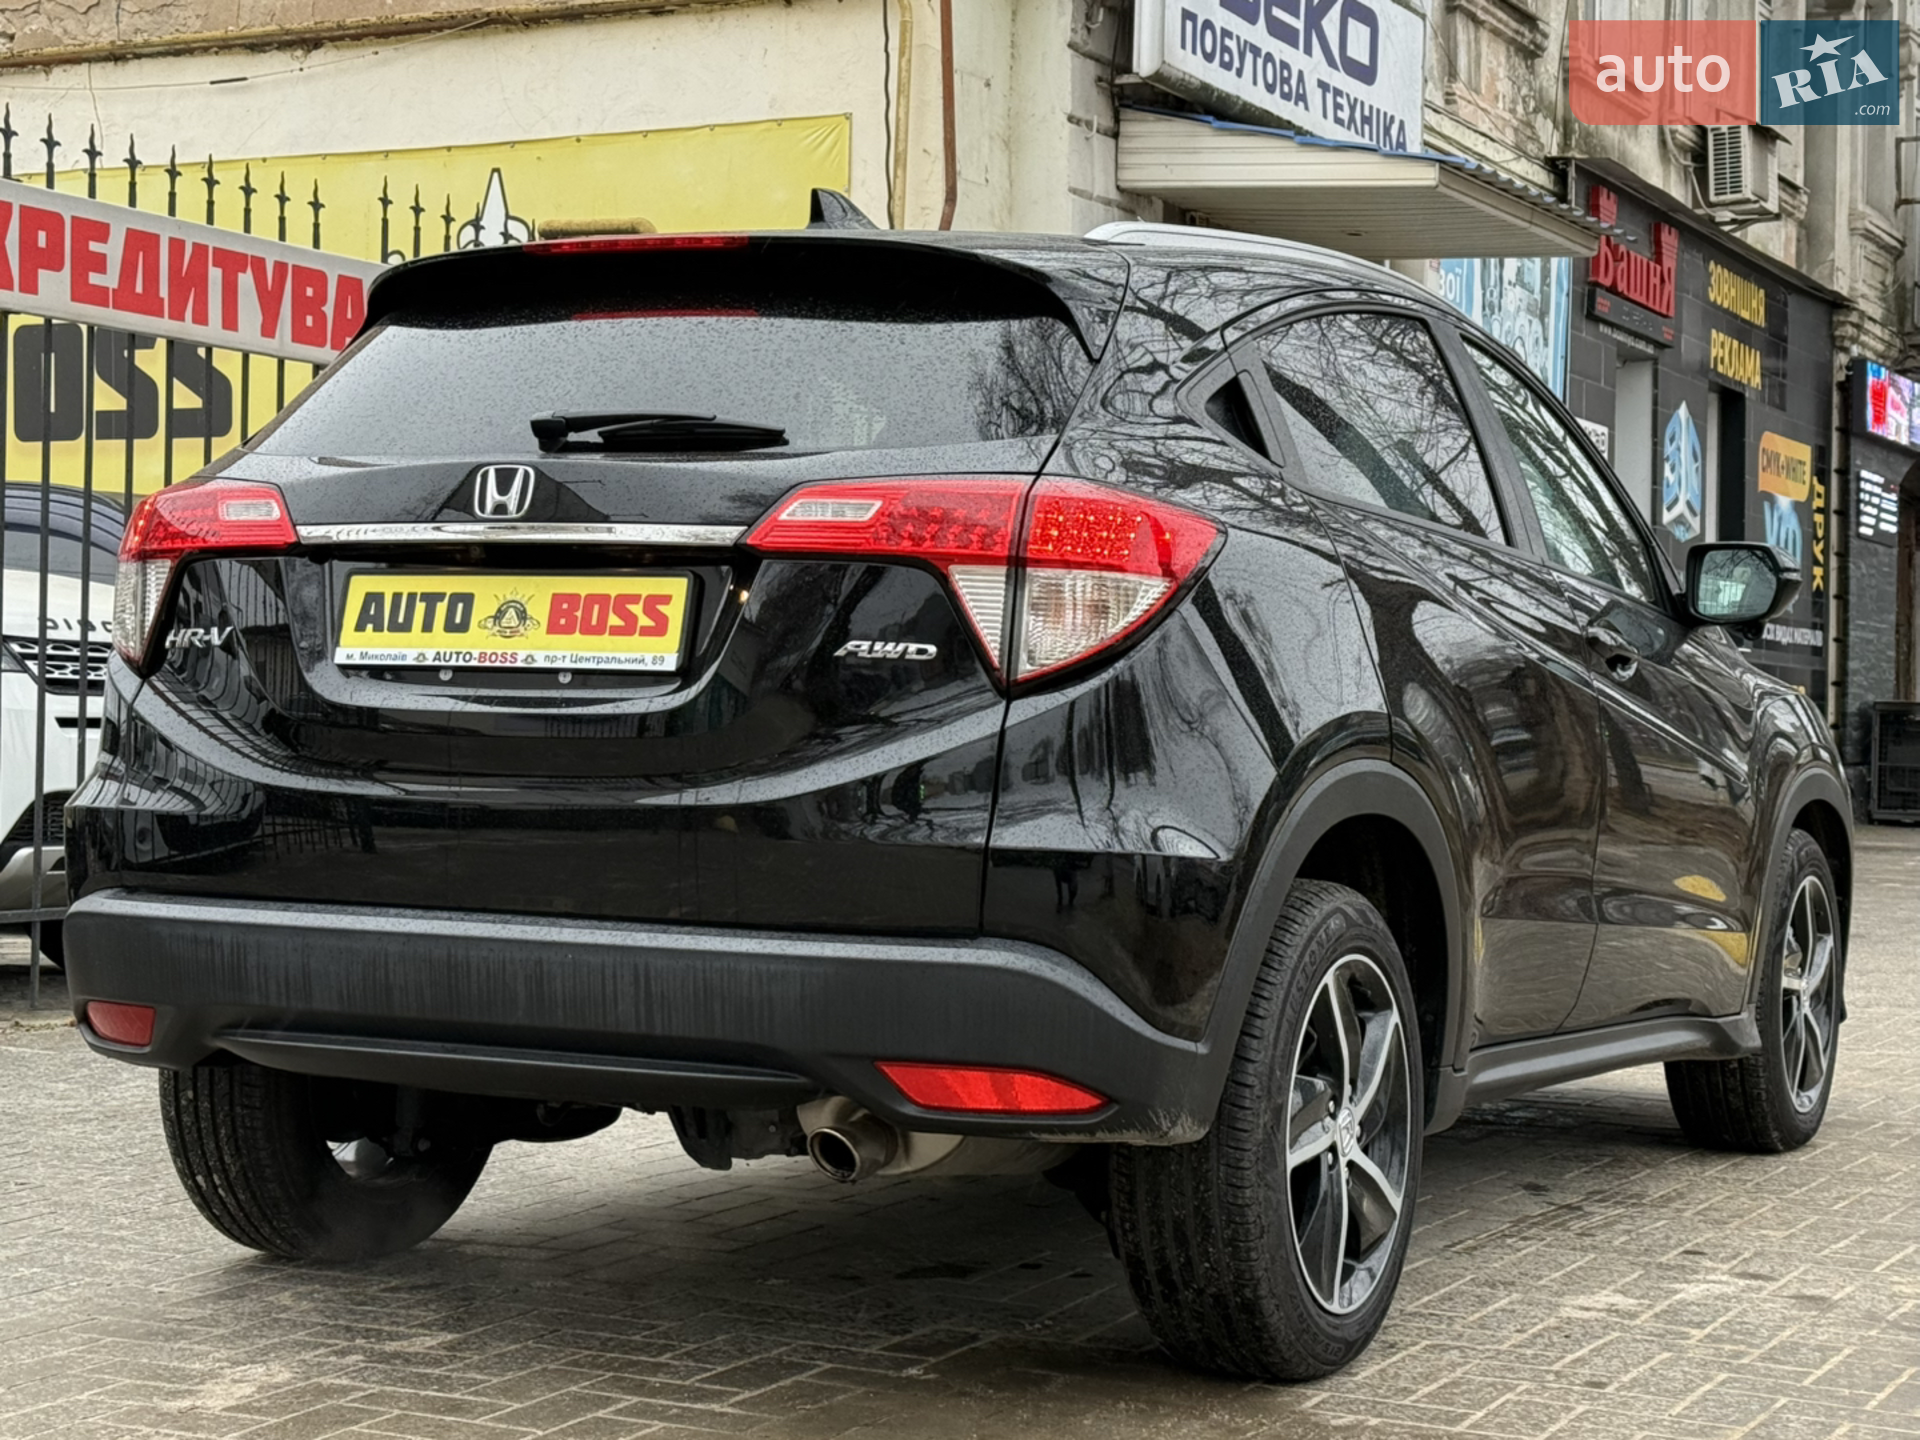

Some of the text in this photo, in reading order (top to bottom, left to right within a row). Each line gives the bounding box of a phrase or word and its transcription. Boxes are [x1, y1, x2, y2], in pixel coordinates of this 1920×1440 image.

[1181, 7, 1408, 152] ПОБУТОВА ТЕХНІКА
[1708, 260, 1766, 328] ЗОВНІШНЯ
[1710, 328, 1762, 390] РЕКЛАМА
[1761, 447, 1807, 486] CMYK+WHITE
[1812, 475, 1826, 592] ДРУК
[164, 625, 234, 648] HR-V
[353, 591, 674, 637] AUTO BOSS
[359, 650, 408, 662] Миколаїв
[432, 650, 519, 664] AUTO-BOSS
[543, 653, 567, 665] пр-т
[569, 653, 649, 667] Центральний,
[651, 655, 665, 666] 89
[833, 639, 938, 660] AWD
